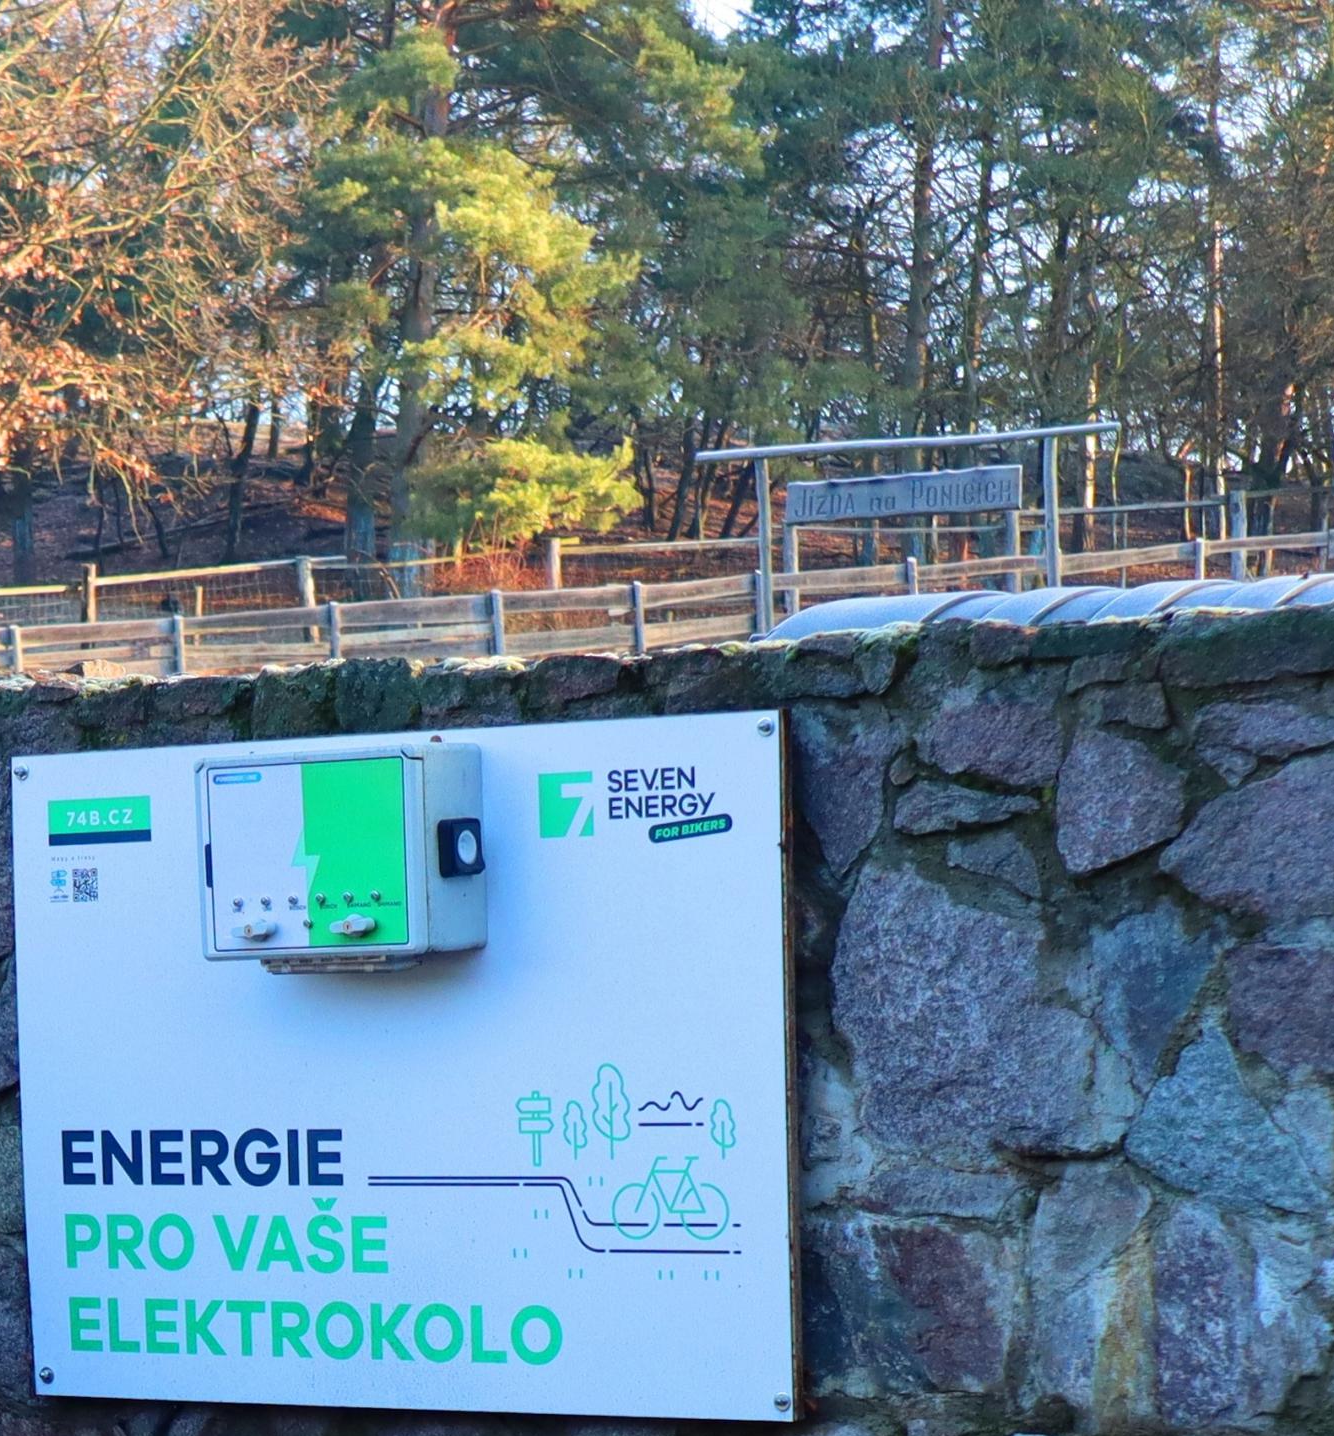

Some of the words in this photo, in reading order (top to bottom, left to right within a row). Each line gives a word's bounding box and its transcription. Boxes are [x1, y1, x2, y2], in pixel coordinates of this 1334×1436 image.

[66, 808, 133, 828] 74B.CZ
[608, 791, 716, 820] ENERGY
[654, 826, 681, 840] FOR
[681, 817, 727, 837] BIKERS
[61, 1127, 344, 1187] ENERGIE
[64, 1213, 195, 1272] PRO
[212, 1197, 389, 1275] VAŠE
[68, 1296, 563, 1366] ELEKTROKOLO
